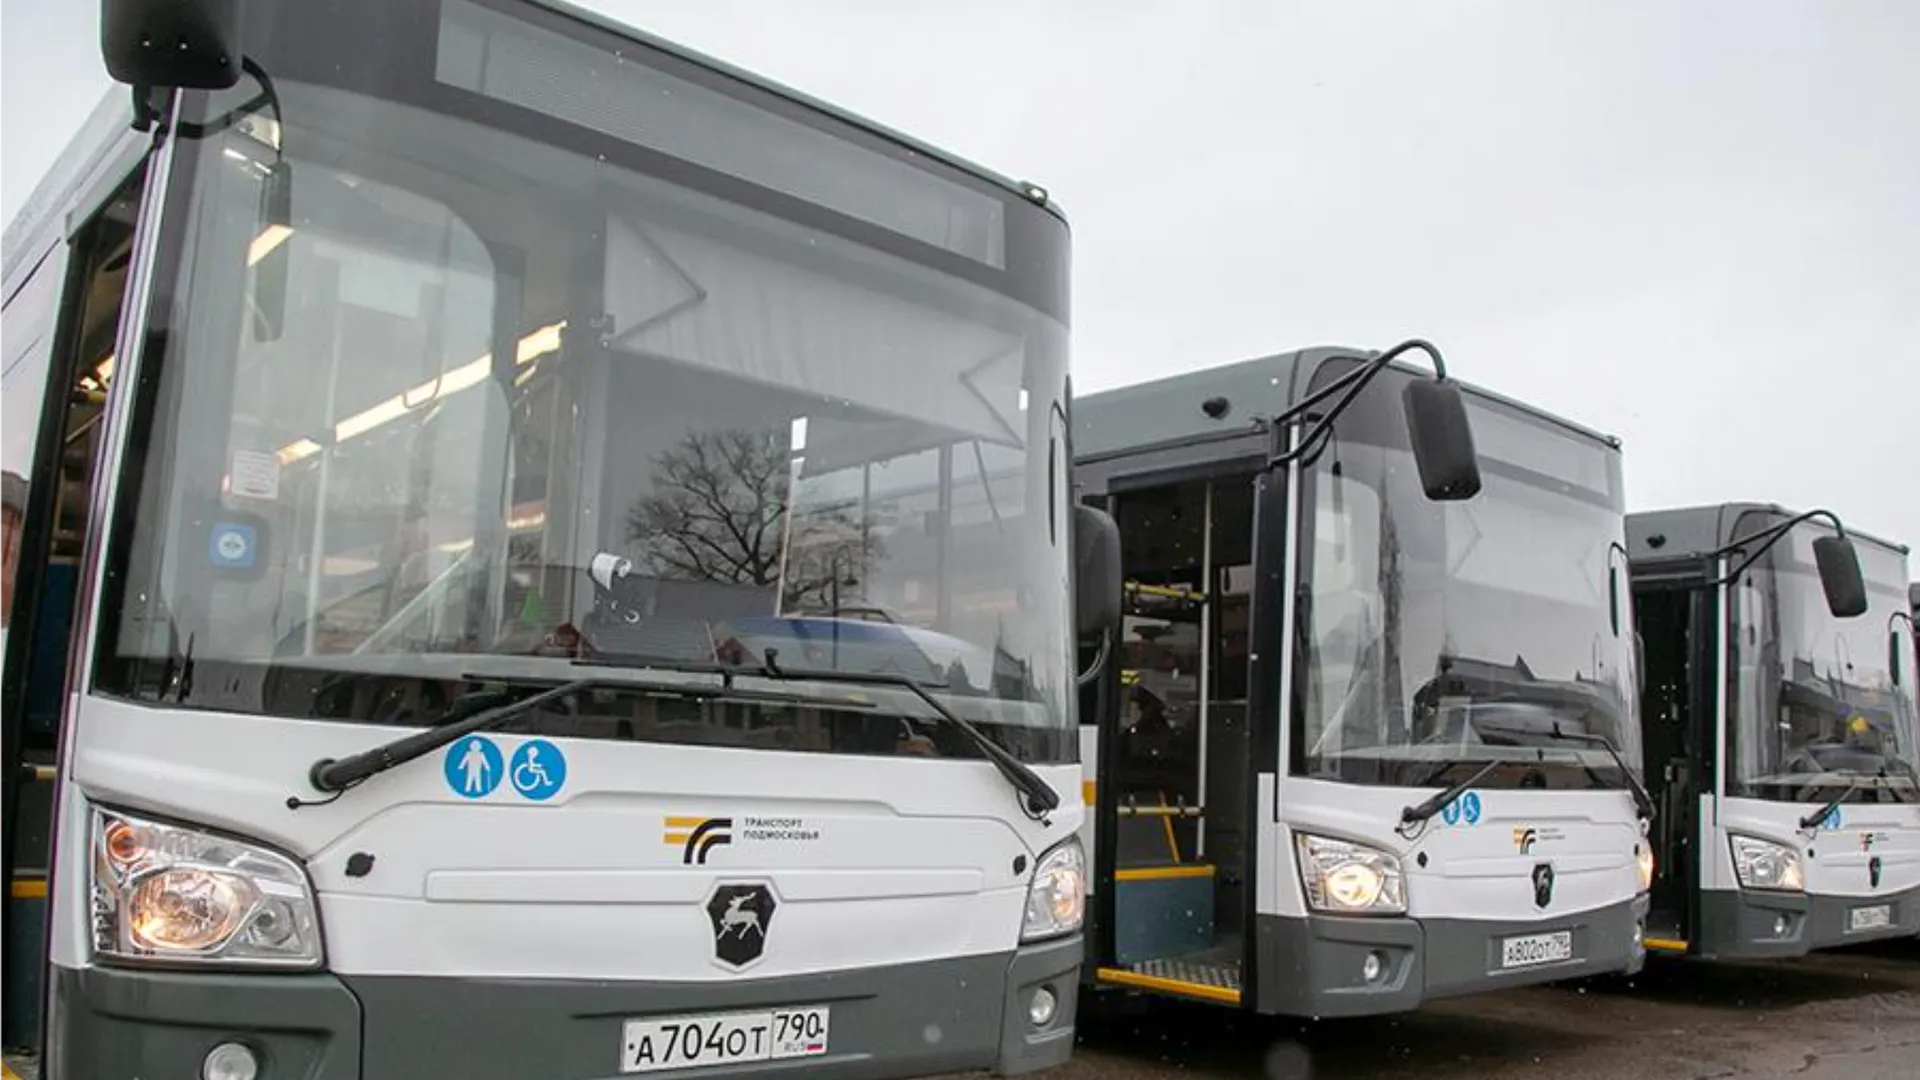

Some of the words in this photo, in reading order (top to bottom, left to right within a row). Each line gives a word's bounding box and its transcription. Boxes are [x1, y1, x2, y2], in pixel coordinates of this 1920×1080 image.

[744, 816, 803, 828] ТРАНСПОРТ
[743, 829, 820, 841] ПОДМОСКОВЬЯ
[635, 1021, 768, 1066] А704ОТ
[776, 1011, 820, 1042] 790
